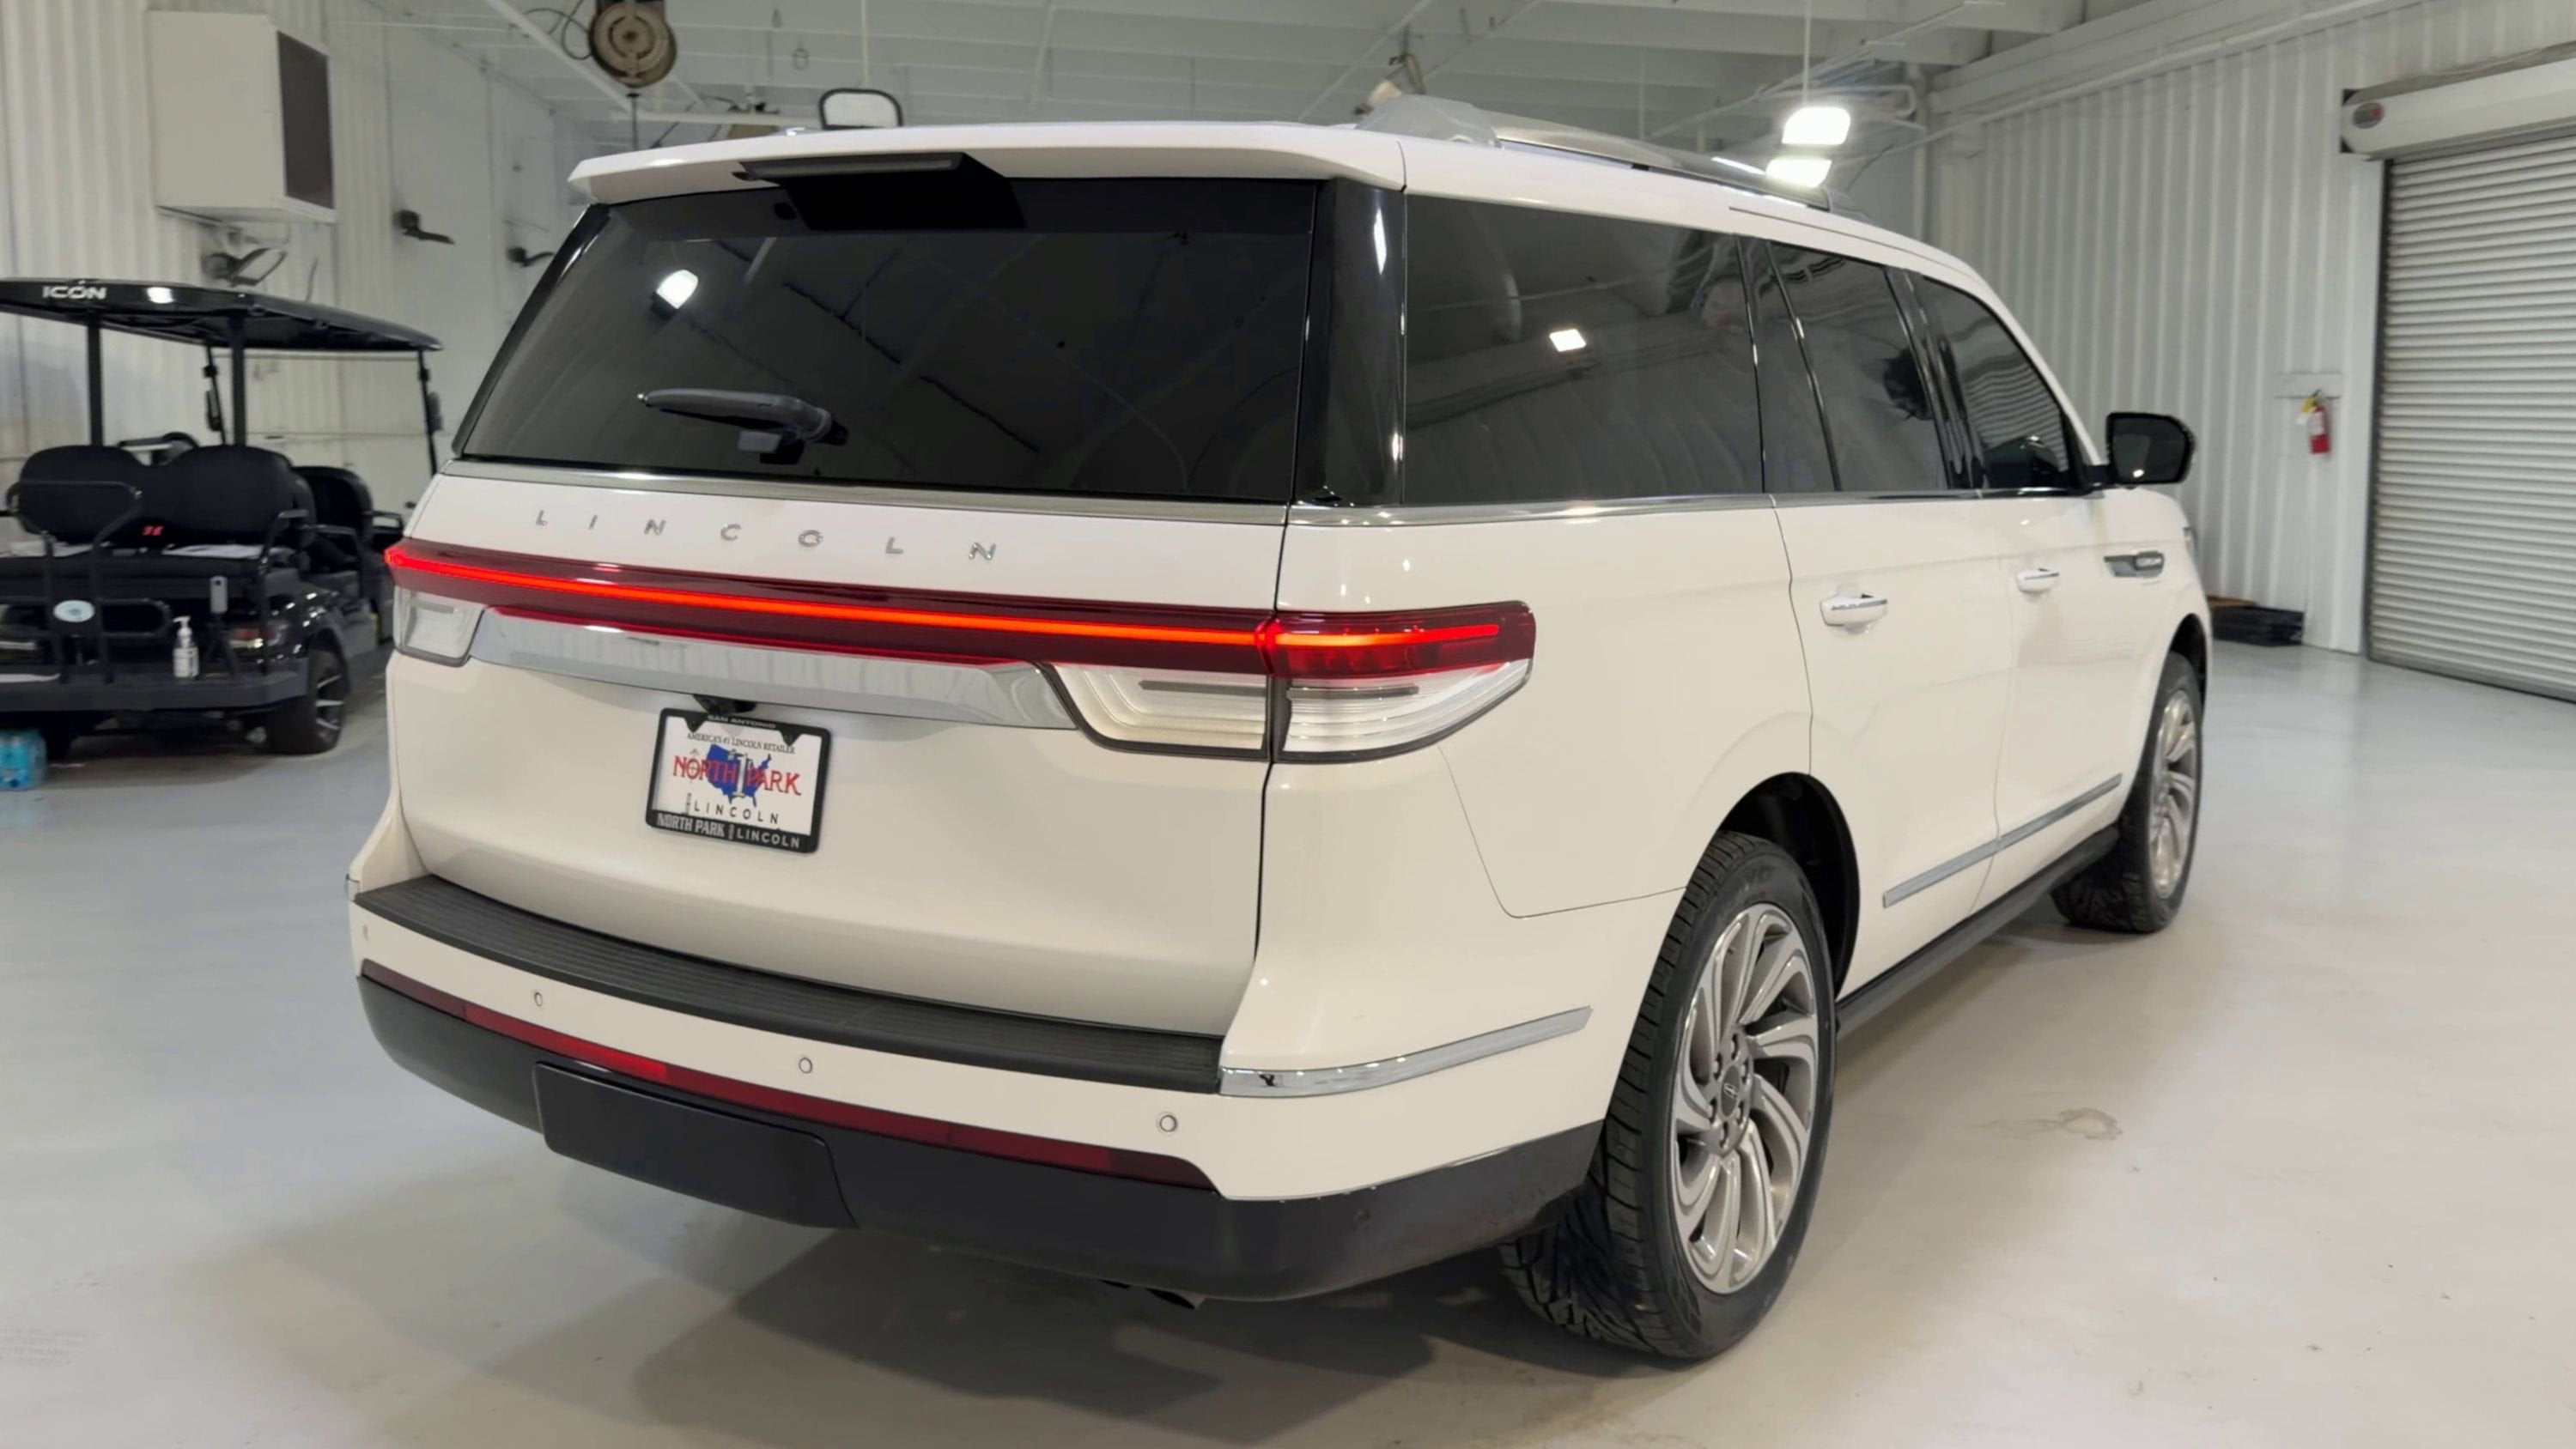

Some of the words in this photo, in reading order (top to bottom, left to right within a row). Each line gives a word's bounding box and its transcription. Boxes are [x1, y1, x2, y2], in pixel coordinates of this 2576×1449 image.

[535, 509, 997, 561] LINCOLN
[708, 714, 729, 723] SAN
[731, 718, 776, 729] ANTONIO
[732, 737, 763, 750] LINCOLN
[763, 742, 796, 755] RETAILER
[673, 755, 738, 784] NORTH
[746, 765, 802, 796] PARK
[694, 800, 779, 824] LINCOLN
[657, 812, 694, 832] NORTH
[695, 819, 725, 838] PARK
[737, 828, 799, 849] LINCOLN
